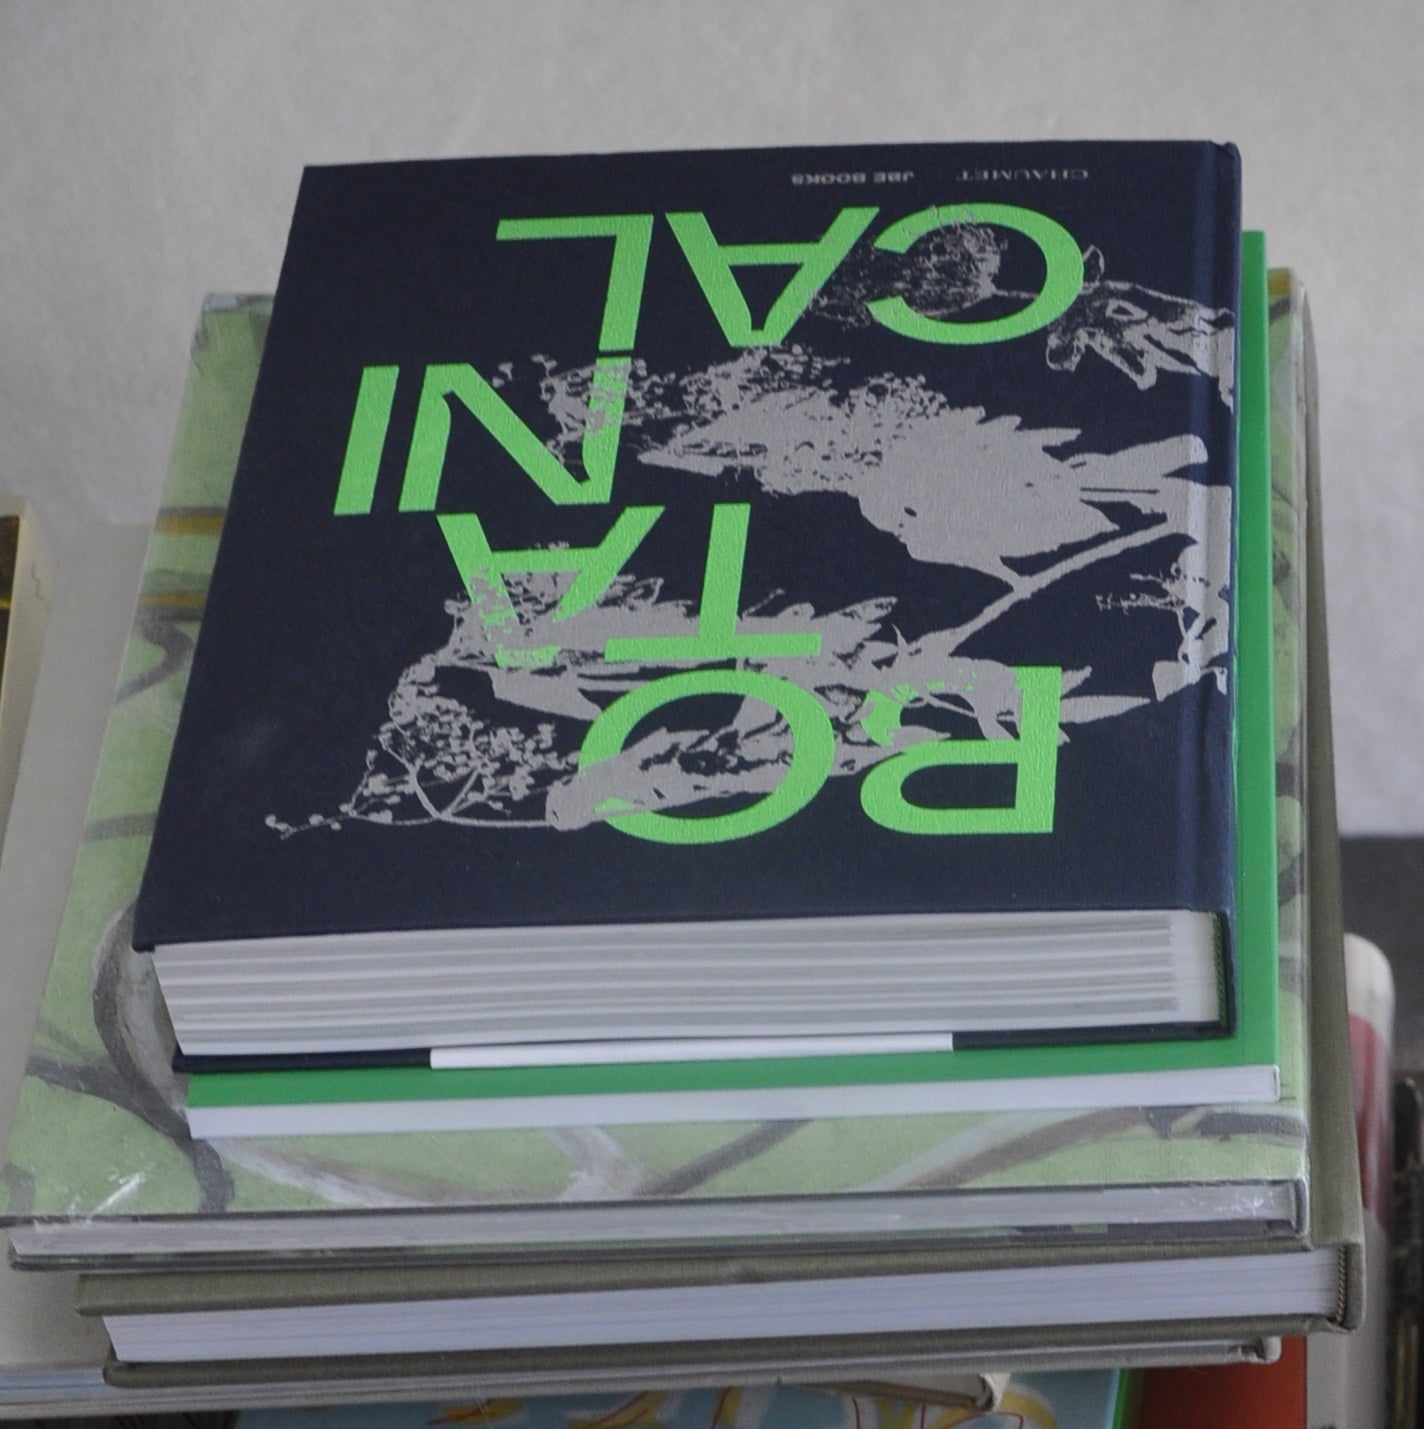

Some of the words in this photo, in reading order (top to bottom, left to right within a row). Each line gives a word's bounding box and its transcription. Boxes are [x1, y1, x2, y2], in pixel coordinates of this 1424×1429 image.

[791, 172, 867, 186] BOOKS
[873, 171, 915, 185] JBE
[955, 168, 1090, 181] CHAUMET
[495, 202, 1084, 352] CAL
[333, 356, 636, 516] NI
[436, 503, 821, 669] TA
